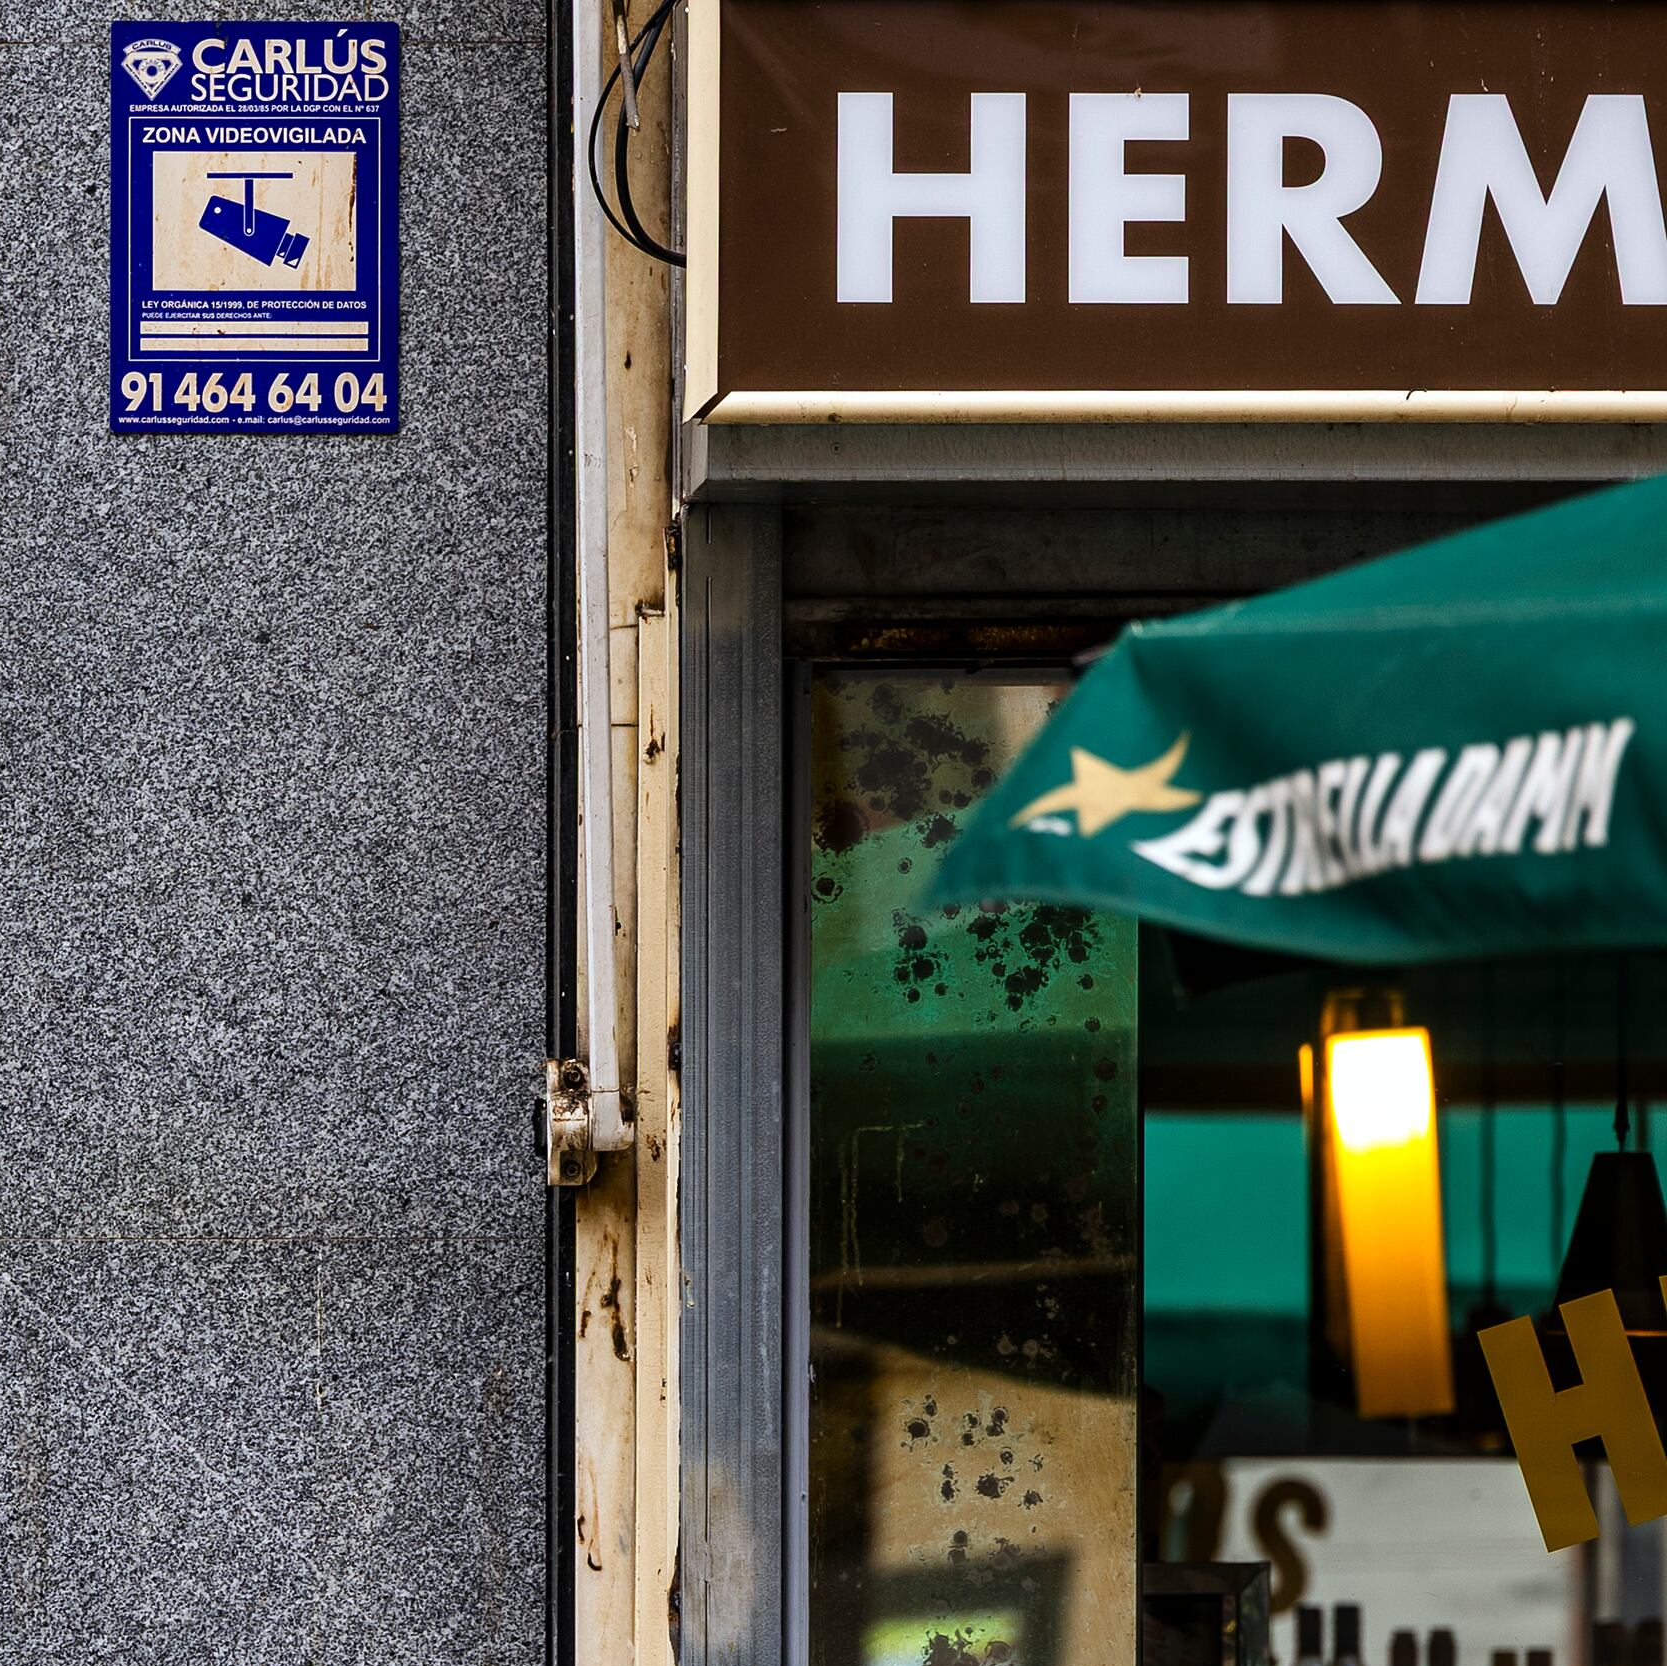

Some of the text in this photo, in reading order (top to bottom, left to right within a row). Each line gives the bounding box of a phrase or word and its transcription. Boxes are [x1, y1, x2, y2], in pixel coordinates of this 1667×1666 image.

[192, 29, 387, 75] CARLÚS
[191, 74, 389, 102] SEGURIDAD
[130, 105, 169, 113] EMPRESA
[170, 105, 224, 113] AUTORIZADA
[226, 105, 236, 113] EL
[238, 105, 269, 113] 28/03/85
[271, 105, 289, 113] POR
[291, 105, 302, 113] LA
[303, 105, 321, 113] DGP
[323, 105, 341, 113] CON
[343, 105, 353, 113] EL
[366, 105, 379, 113] 637
[142, 127, 367, 144] ZONA VIDEOVIGILADA
[837, 92, 1667, 304] HERM
[142, 301, 159, 309] LEY
[161, 299, 209, 309] ORGÁNICA
[247, 301, 259, 309] DE
[262, 299, 320, 309] PROTECCIÓN
[322, 301, 334, 309] DE
[337, 301, 367, 309] DATOS
[121, 372, 387, 413] 91 464 64 04
[119, 416, 229, 425] www.carlusseguridad.com
[268, 415, 390, 425] carlus@carlusseguridad.com
[1129, 748, 1447, 896] ESTRELLA
[1477, 1274, 1667, 1553] H
